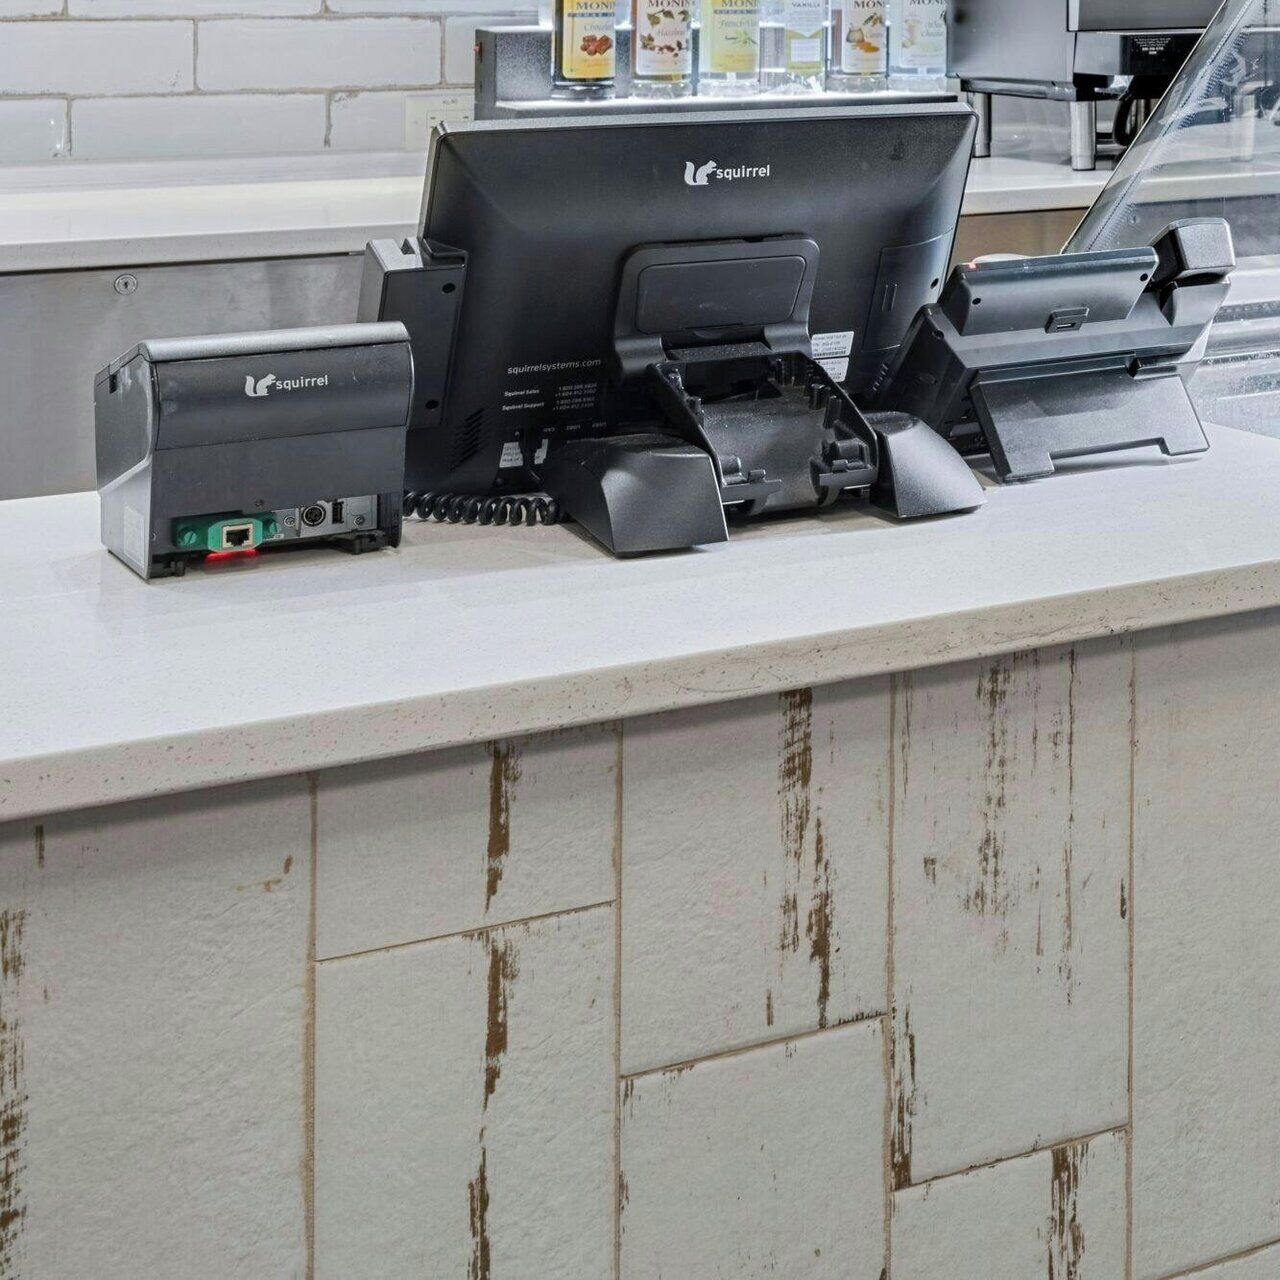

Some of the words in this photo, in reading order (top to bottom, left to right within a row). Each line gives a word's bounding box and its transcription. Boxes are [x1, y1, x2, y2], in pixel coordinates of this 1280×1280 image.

[716, 164, 770, 181] squirrel
[507, 359, 601, 376] squirrelsystems.com
[276, 374, 328, 391] squirrel
[504, 389, 525, 397] Squirrel
[502, 403, 523, 411] Squirrel
[524, 401, 545, 410] Support
